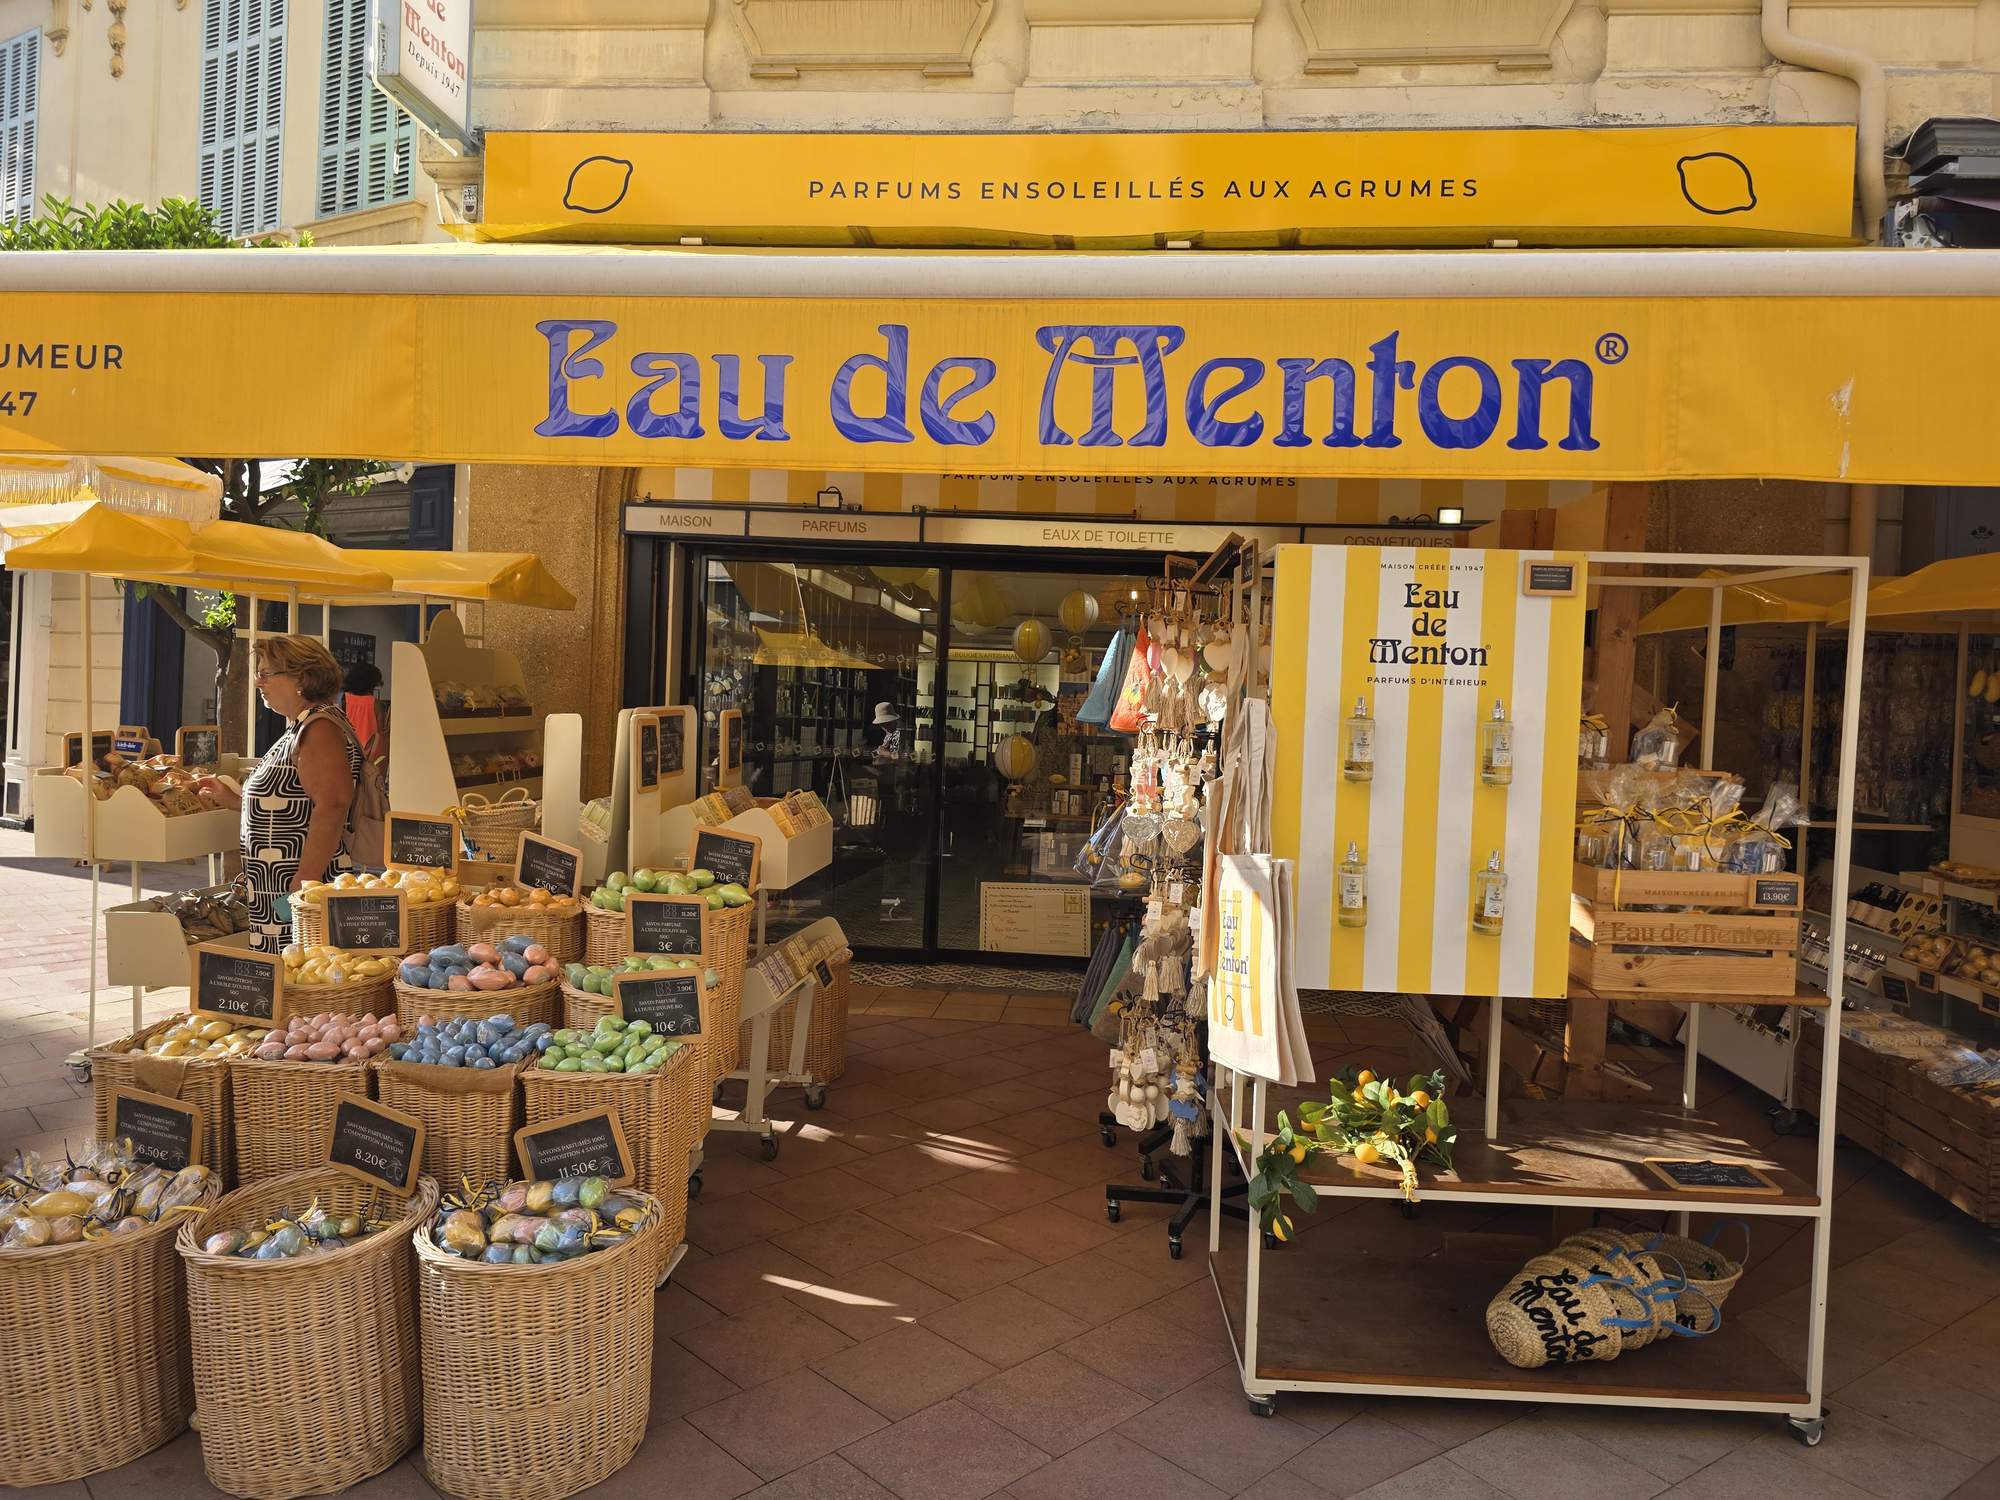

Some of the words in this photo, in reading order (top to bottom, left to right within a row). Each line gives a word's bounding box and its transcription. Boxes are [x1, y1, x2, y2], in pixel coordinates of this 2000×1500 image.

[404, 2, 464, 80] Menton
[408, 41, 438, 79] Depuis
[441, 73, 461, 97] 1947
[809, 181, 961, 199] PARFUMS
[981, 176, 1205, 199] ENSOLEILLÉS
[1223, 180, 1290, 198] AUX
[1309, 179, 1477, 198] AGRUMES
[534, 319, 794, 441] Eau
[830, 323, 997, 447] de
[1208, 477, 1297, 487] AGRUMES
[659, 514, 713, 528] MAISON
[801, 519, 868, 534] PARFUMS
[1042, 528, 1081, 542] EAUX
[1084, 529, 1104, 543] DE
[1107, 530, 1175, 545] TOILETTE
[1403, 583, 1461, 609] Eau
[1412, 611, 1447, 637] de
[1367, 676, 1416, 685] PARFUMS
[406, 853, 433, 864] 3.70€
[1762, 892, 1790, 901] 13.90€
[355, 934, 370, 944] 3€
[1224, 931, 1235, 950] de
[1611, 921, 1653, 943] Eau
[1660, 923, 1689, 944] de
[1693, 923, 1783, 946] Menton
[658, 941, 673, 951] 3€
[218, 998, 249, 1013] 2.10€
[138, 1144, 168, 1160] 6.50€
[355, 1148, 388, 1170] 8.20€
[538, 1146, 561, 1156] SAVONS
[540, 1150, 580, 1165] COMPOSITION
[585, 1142, 609, 1153] SAVONS
[558, 1160, 599, 1179] 11.50€
